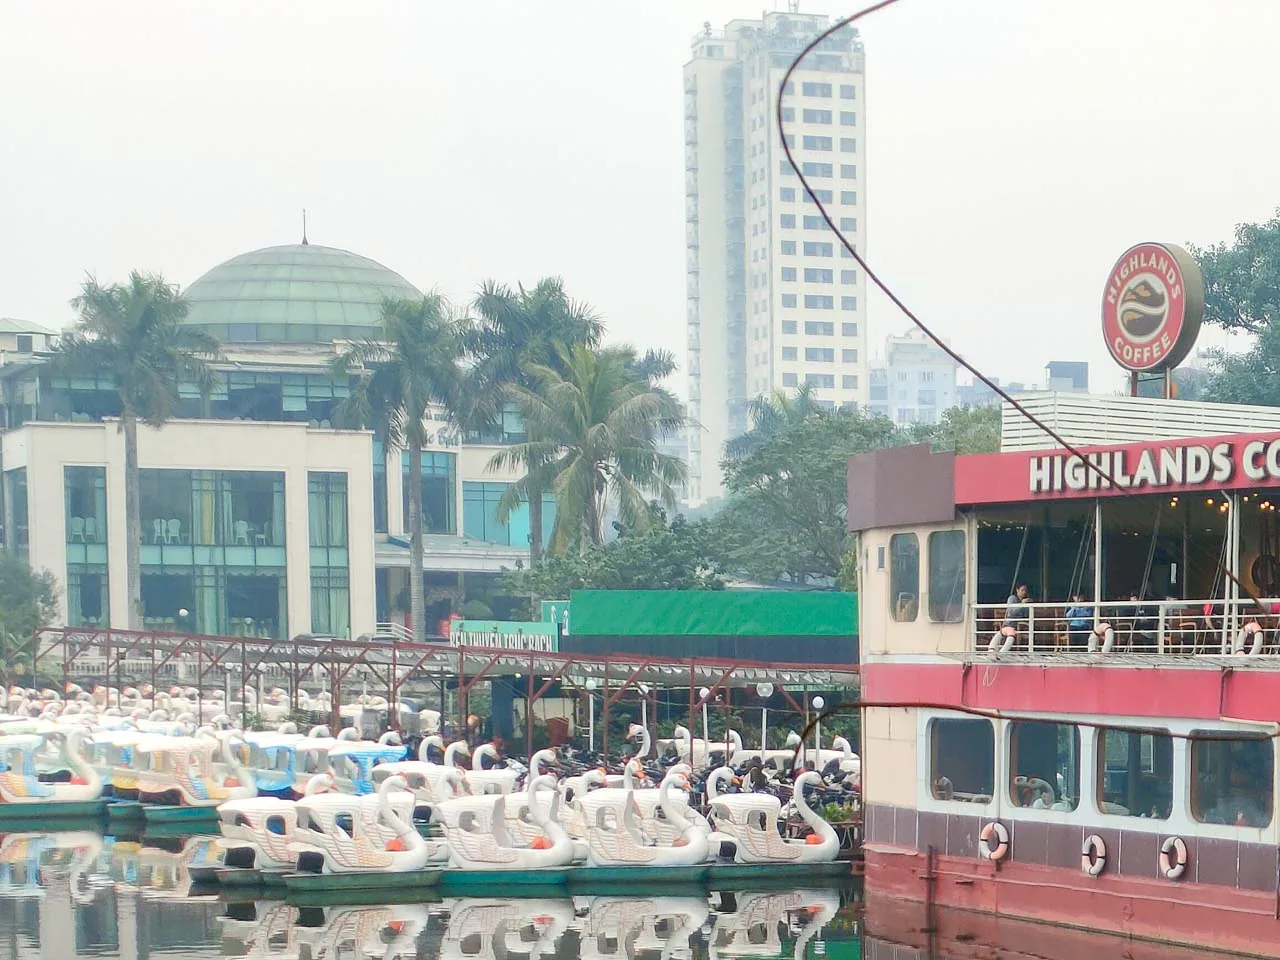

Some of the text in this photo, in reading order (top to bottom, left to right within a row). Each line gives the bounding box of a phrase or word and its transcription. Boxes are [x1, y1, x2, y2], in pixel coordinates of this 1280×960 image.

[1107, 251, 1181, 304] HIGHLANDS
[1114, 332, 1171, 363] COFFEE
[1029, 441, 1234, 493] HIGHLANDS
